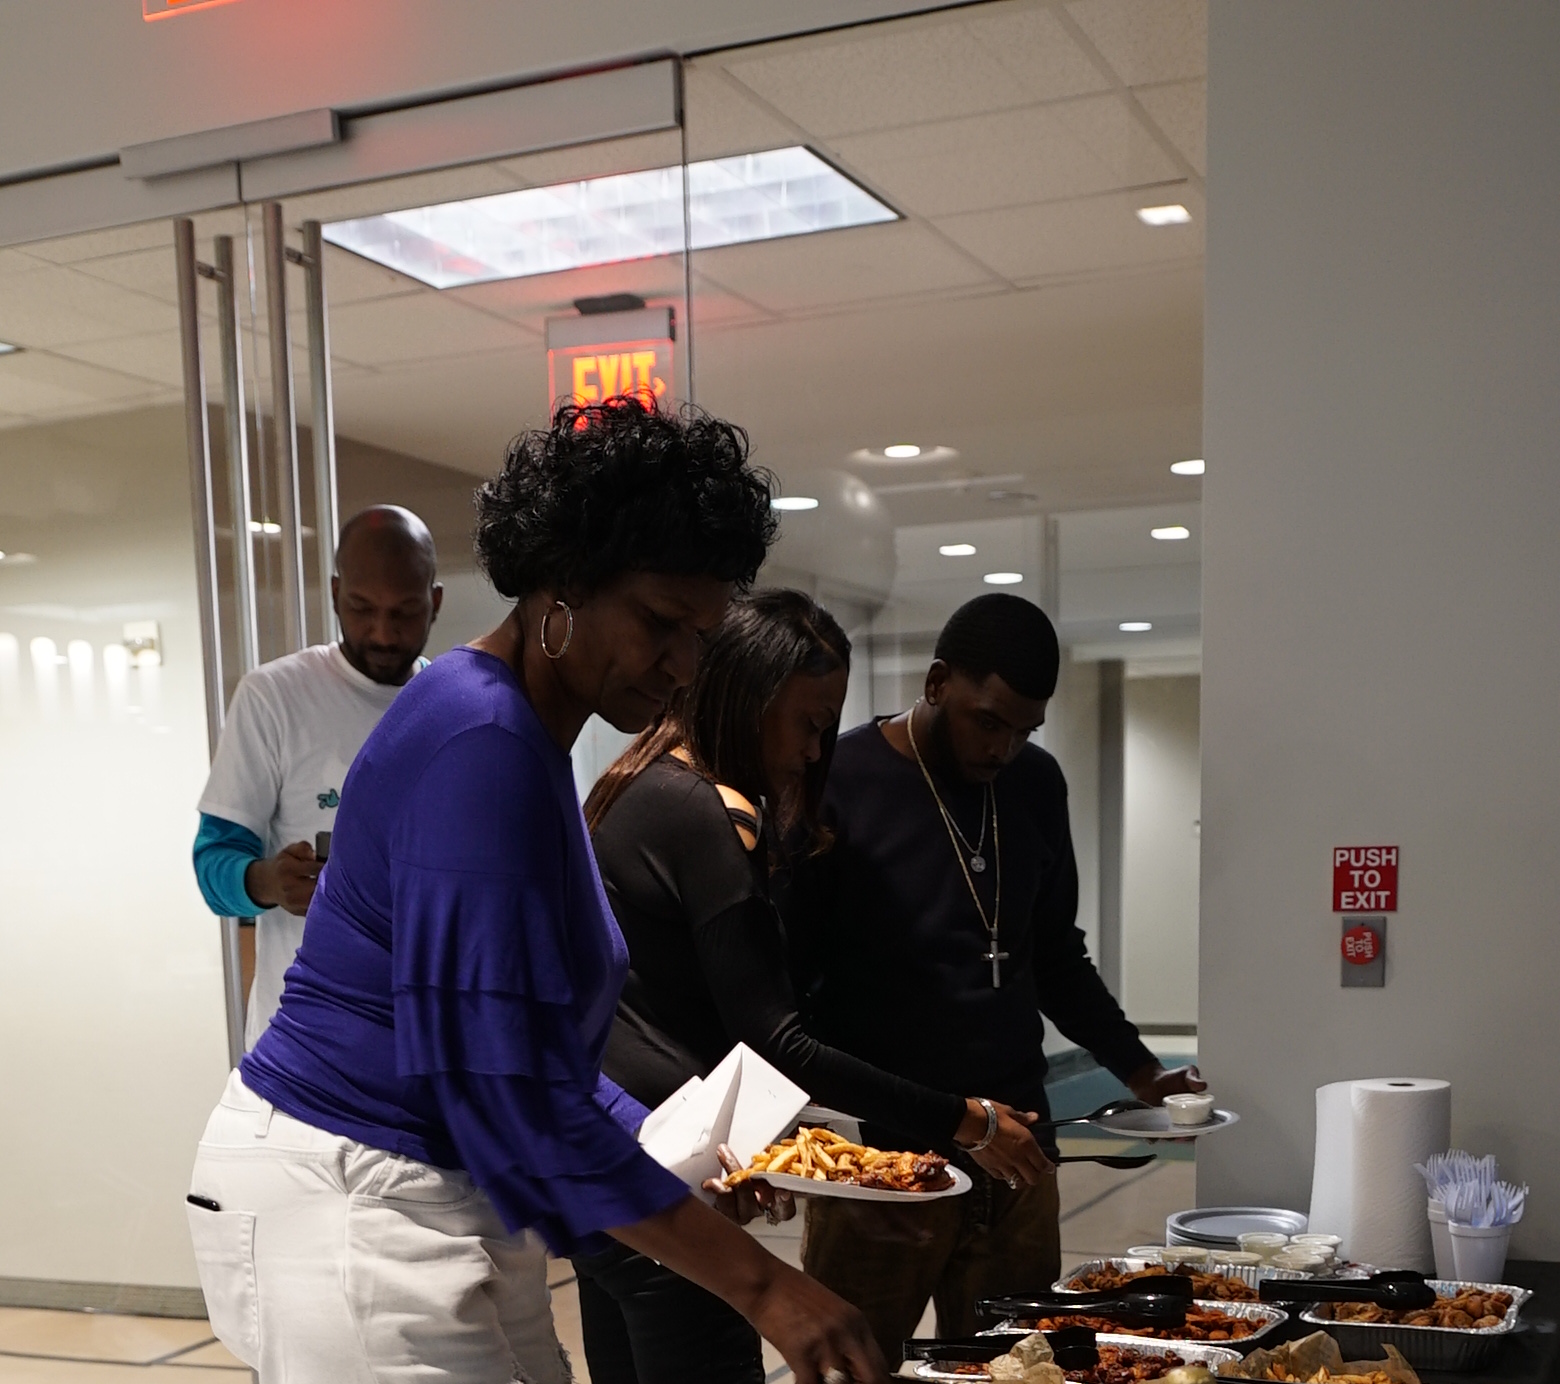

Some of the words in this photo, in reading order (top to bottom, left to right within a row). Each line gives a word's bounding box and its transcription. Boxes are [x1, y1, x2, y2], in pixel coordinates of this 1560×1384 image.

[572, 351, 656, 428] EXIT
[1335, 848, 1397, 867] PUSH
[1349, 869, 1381, 888] TO
[1340, 891, 1391, 909] EXIT
[1345, 936, 1356, 957] EXIT
[1355, 939, 1364, 953] TO
[1362, 931, 1374, 959] PUSH
